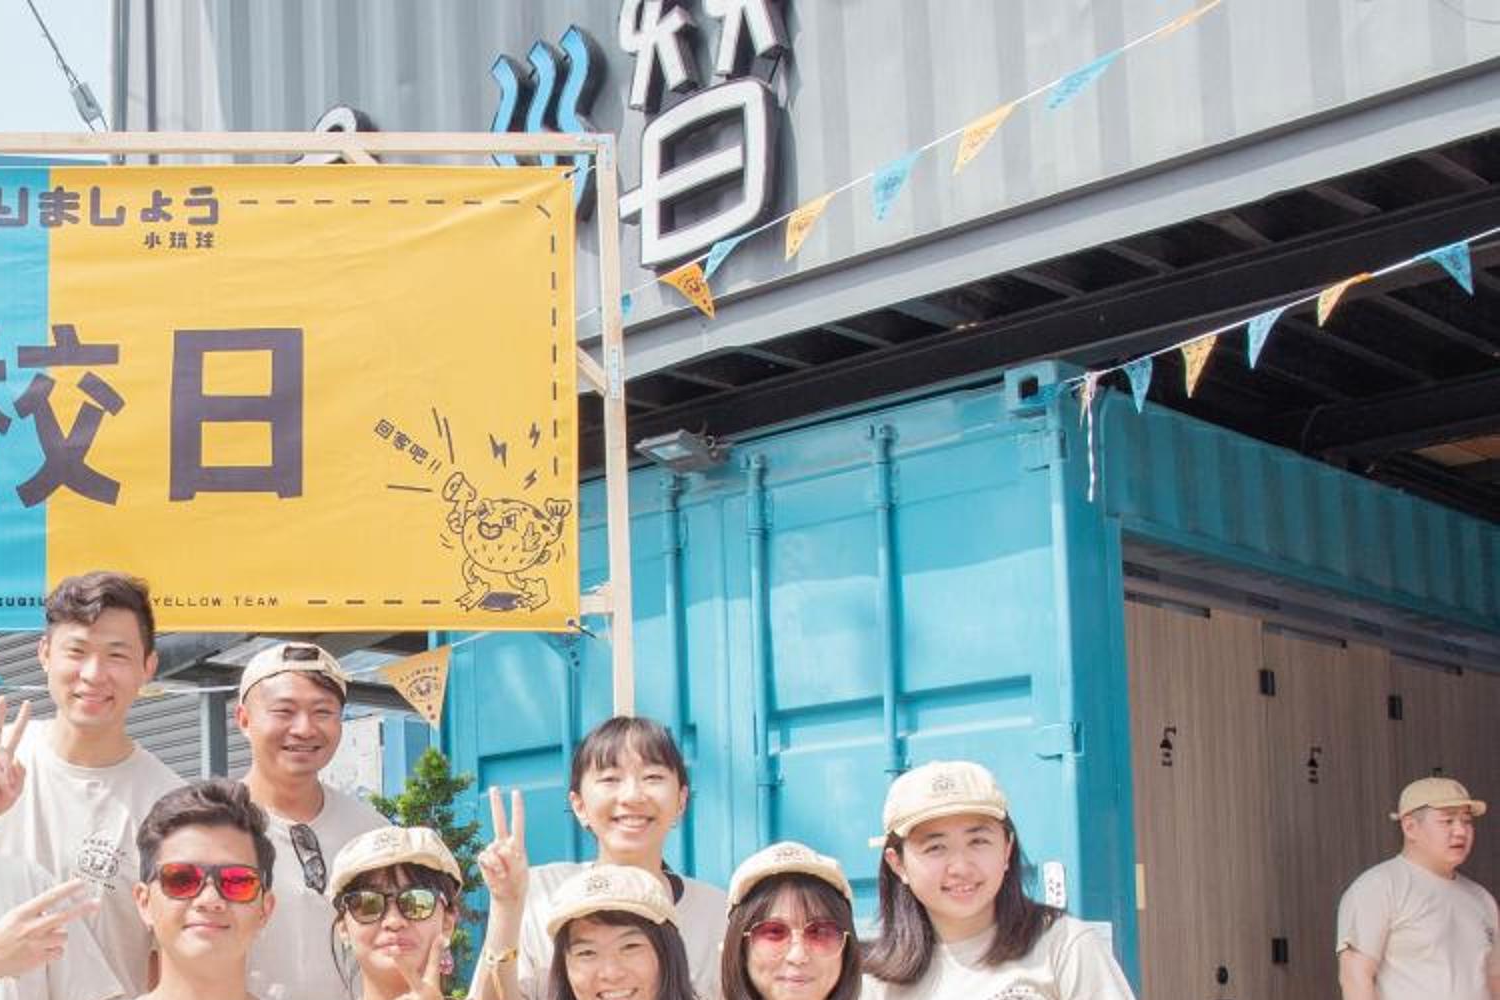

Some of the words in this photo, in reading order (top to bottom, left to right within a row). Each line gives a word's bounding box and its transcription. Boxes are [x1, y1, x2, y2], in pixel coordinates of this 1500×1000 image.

[144, 231, 215, 249] 小琉球
[152, 597, 221, 607] YELLOW
[233, 596, 279, 607] TEAM
